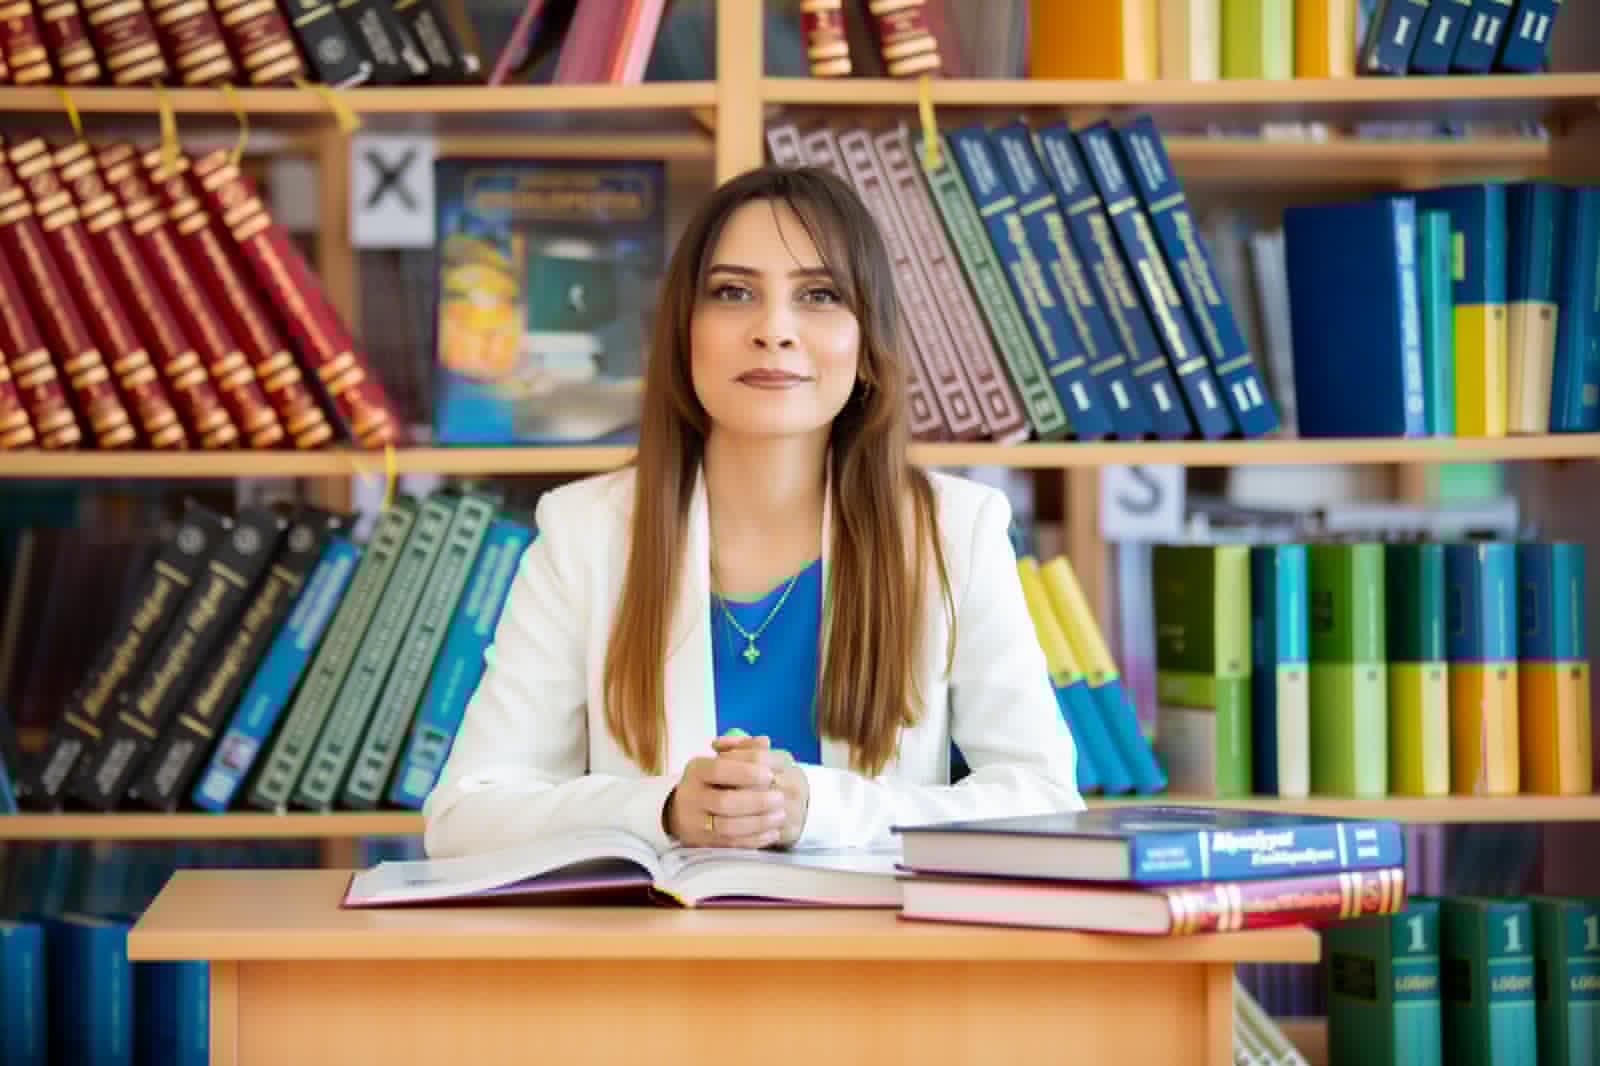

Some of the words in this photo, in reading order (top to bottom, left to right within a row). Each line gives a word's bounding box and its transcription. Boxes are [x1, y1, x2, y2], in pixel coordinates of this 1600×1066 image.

[364, 147, 418, 211] X
[1407, 913, 1428, 952] 1
[1503, 913, 1524, 952] 1
[1584, 913, 1600, 952] 1
